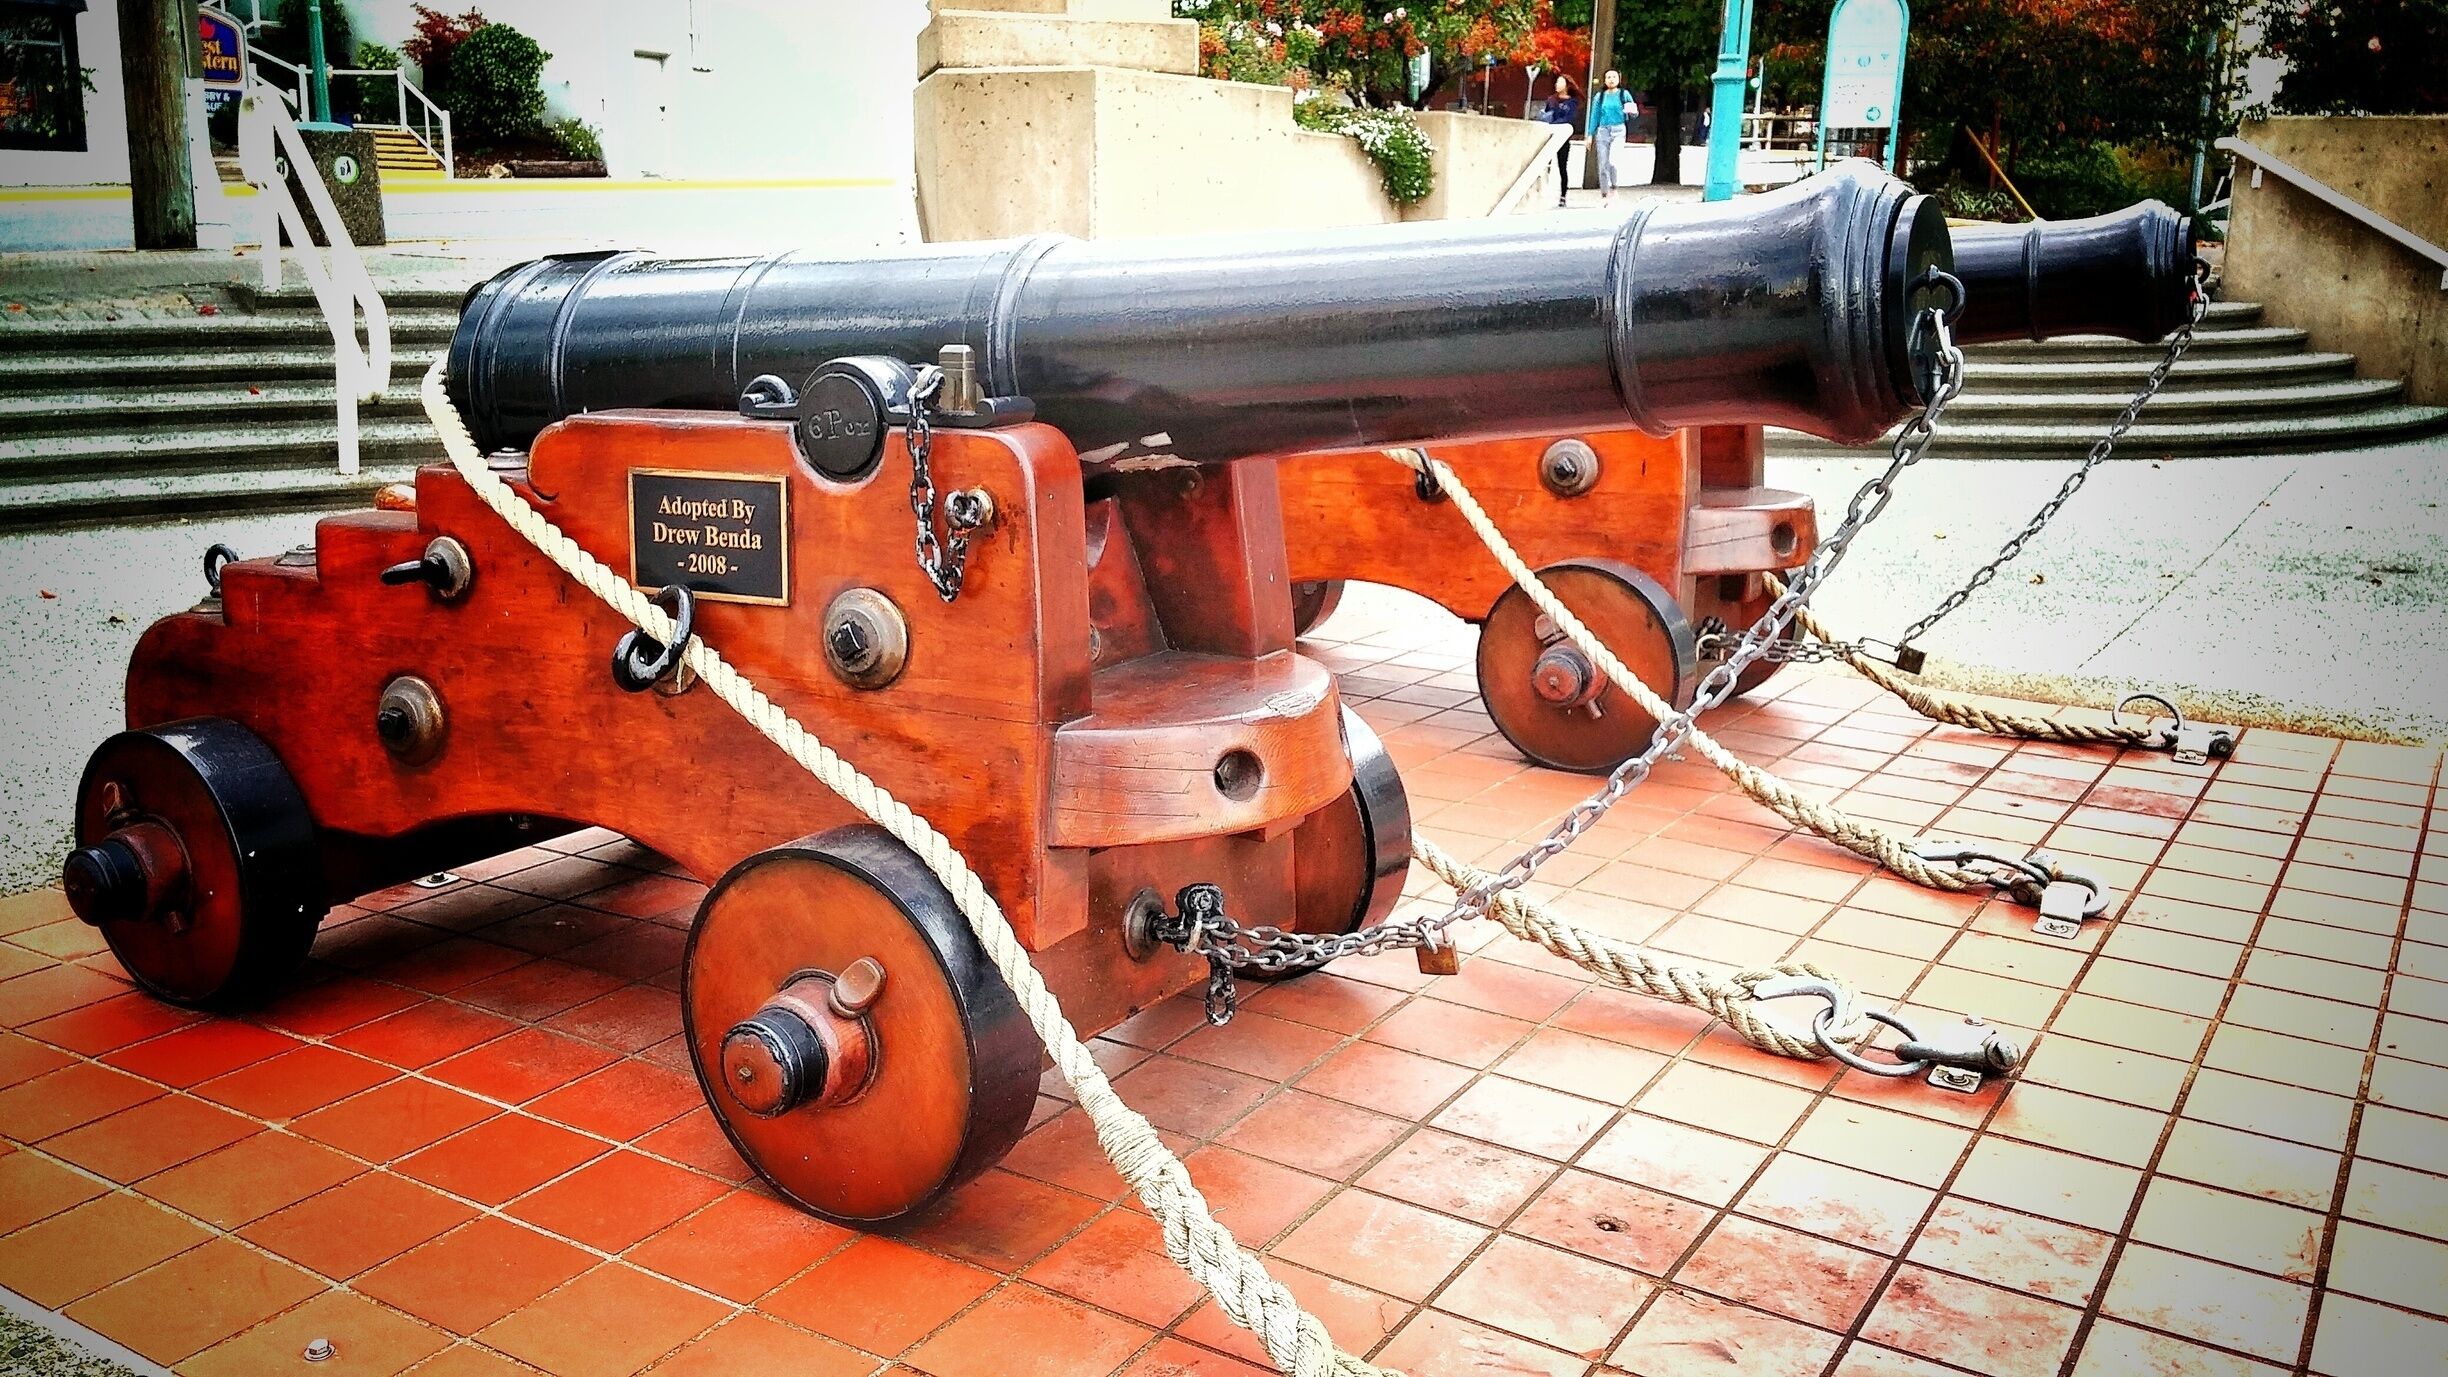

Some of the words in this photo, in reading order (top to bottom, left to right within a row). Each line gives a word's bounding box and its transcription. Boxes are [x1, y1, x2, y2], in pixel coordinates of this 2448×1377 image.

[658, 495, 728, 521] Adopted
[732, 499, 756, 524] By
[653, 522, 701, 545] Drew
[705, 525, 762, 550] Benda
